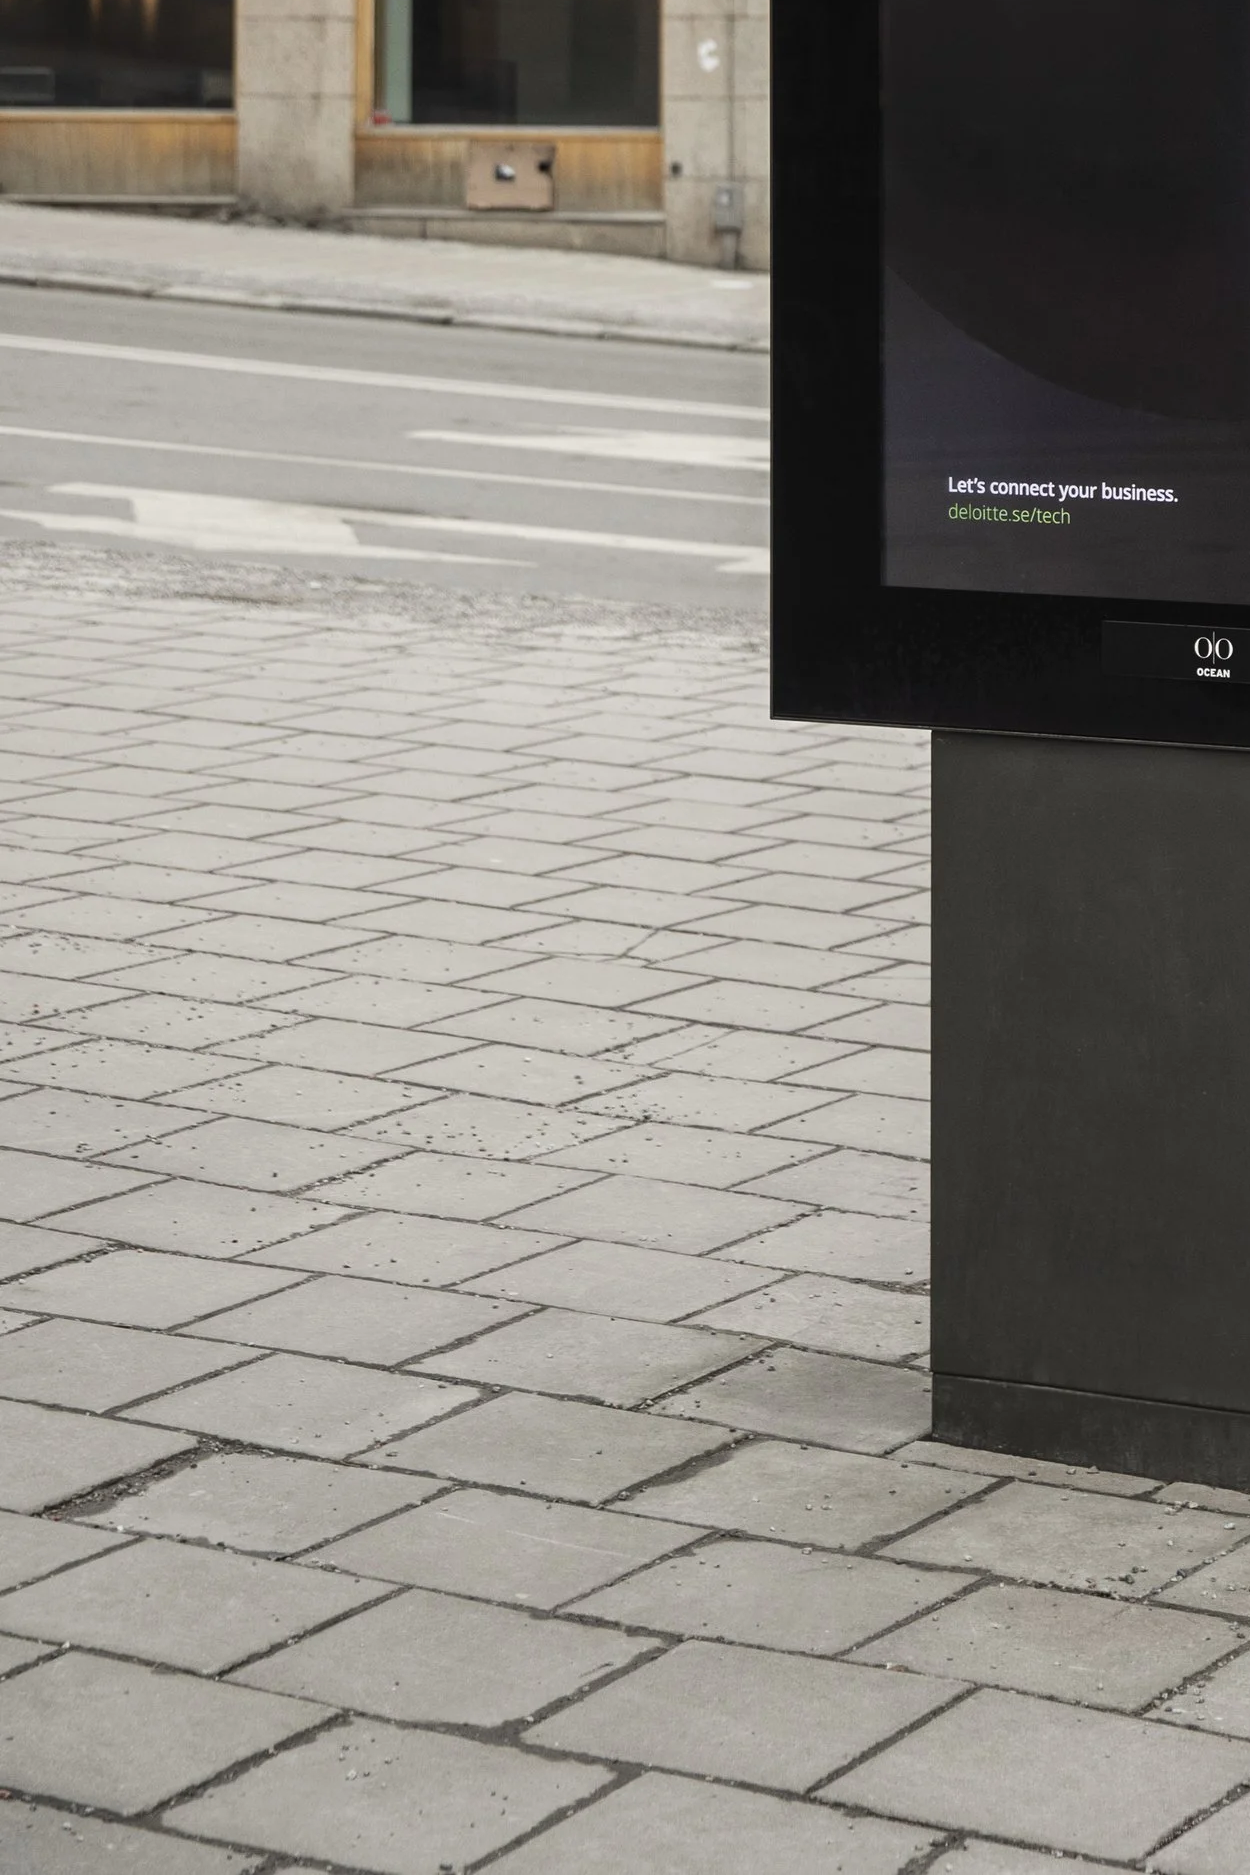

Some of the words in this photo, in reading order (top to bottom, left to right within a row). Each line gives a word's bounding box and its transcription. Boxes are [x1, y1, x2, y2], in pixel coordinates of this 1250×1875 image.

[948, 476, 986, 495] Let’s
[989, 481, 1056, 498] connect
[1058, 484, 1098, 502] your
[1101, 481, 1179, 503] business.
[948, 502, 1072, 525] deloitte.se/tech
[1196, 667, 1232, 679] OCEAN
